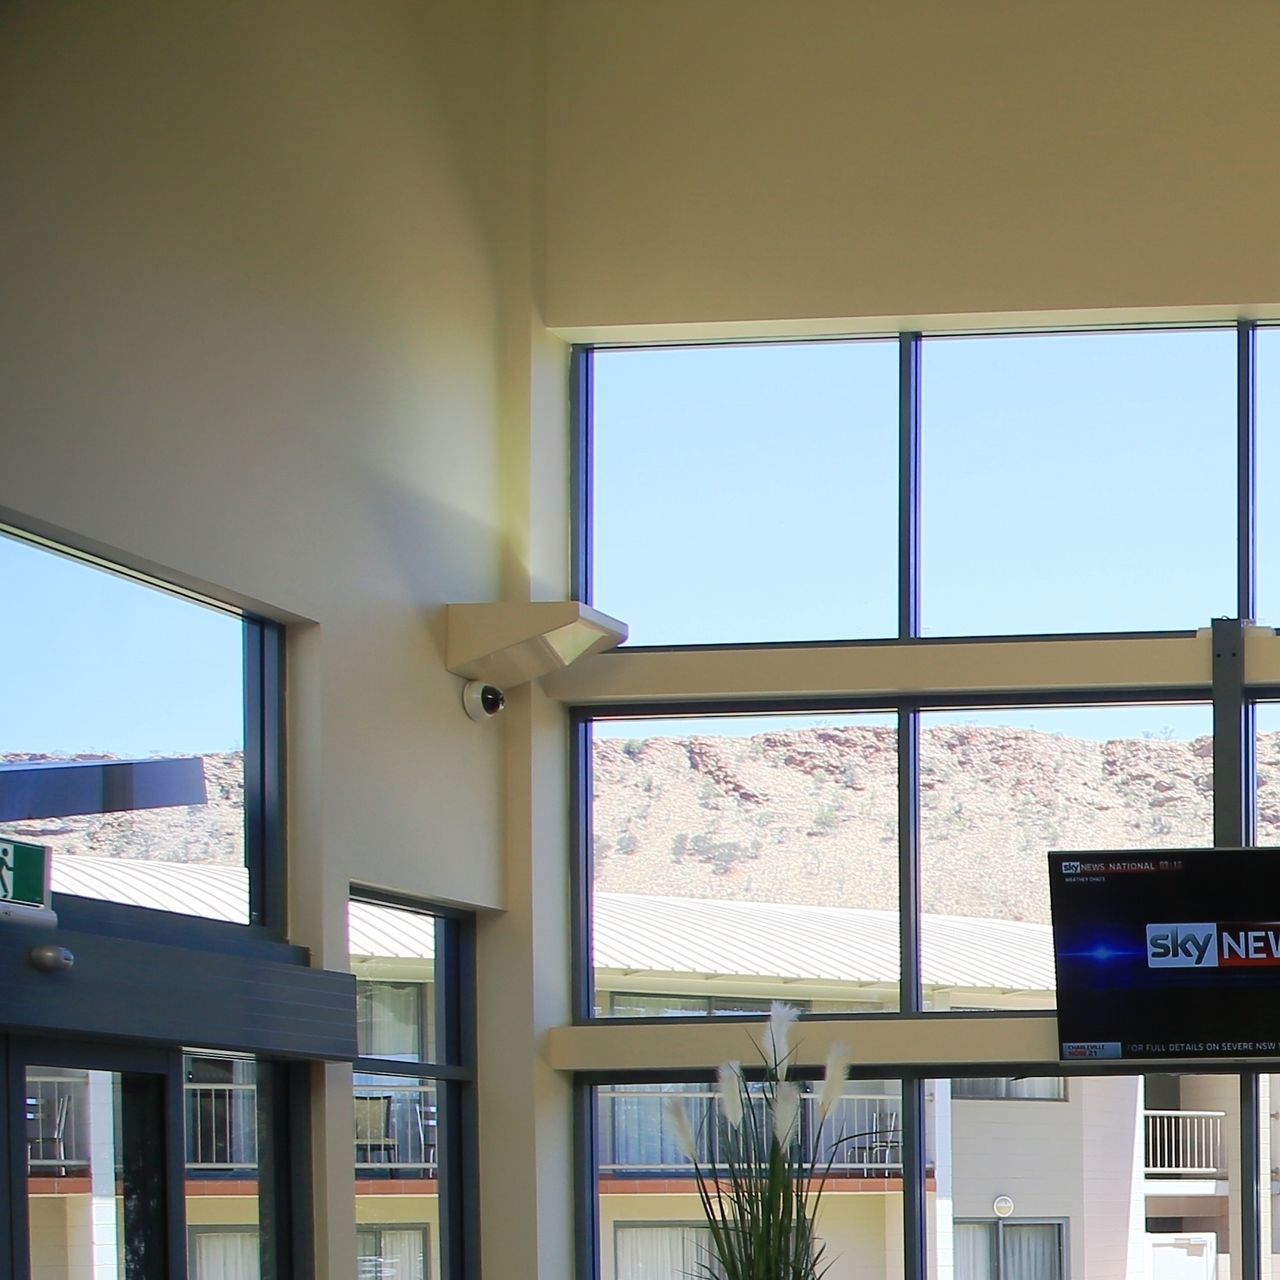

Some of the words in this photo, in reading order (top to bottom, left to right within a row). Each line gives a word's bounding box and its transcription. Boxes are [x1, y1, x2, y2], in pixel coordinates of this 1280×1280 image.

[1062, 862, 1080, 873] sky
[1081, 863, 1105, 871] NEWS
[1109, 862, 1155, 870] NATIONAL
[1150, 926, 1213, 965] sky
[1169, 1043, 1203, 1051] DETAILS
[1222, 1042, 1253, 1050] SEVERE
[1256, 1042, 1276, 1050] NSW
